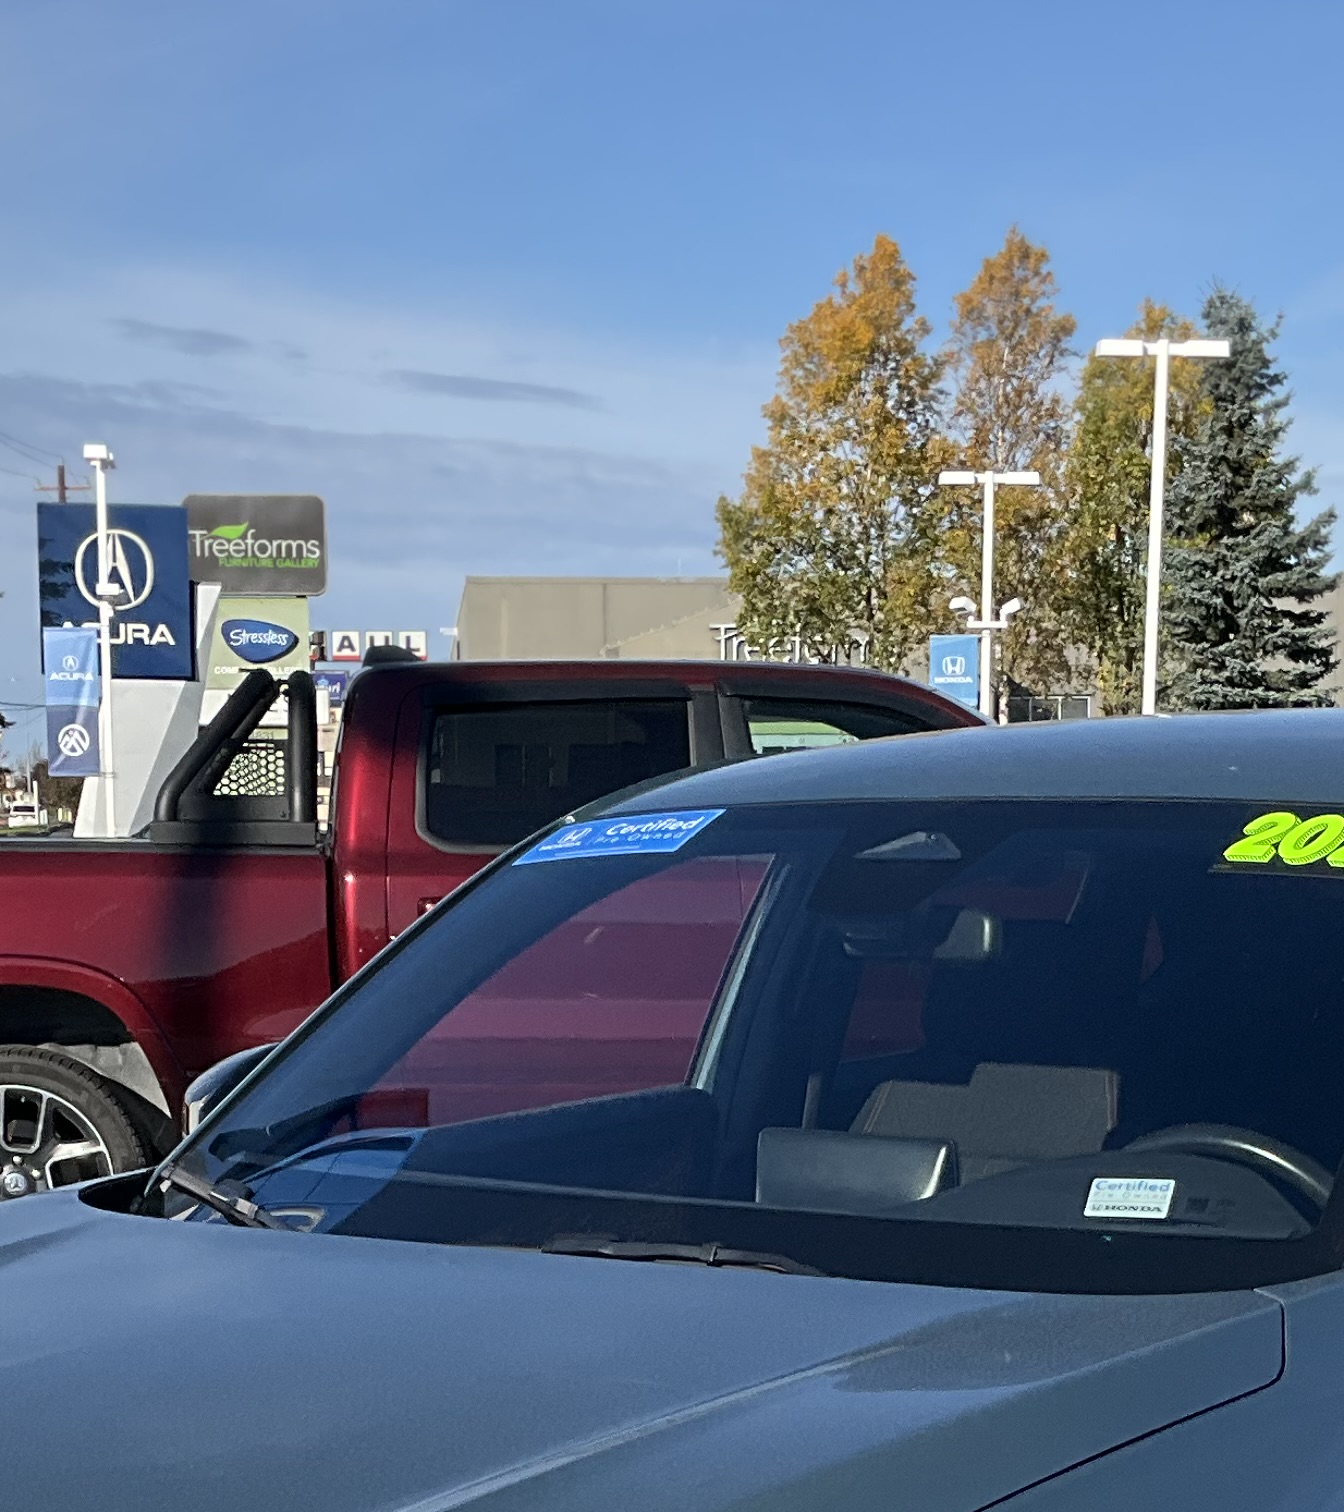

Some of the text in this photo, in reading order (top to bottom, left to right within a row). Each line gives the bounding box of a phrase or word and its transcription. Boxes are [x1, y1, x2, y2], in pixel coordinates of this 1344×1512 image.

[188, 529, 320, 558] Treeforms
[218, 559, 319, 568] FURNITURE GALLERY
[62, 621, 176, 646] URA
[229, 629, 289, 646] Stressless
[49, 672, 94, 681] ACURA
[606, 816, 705, 836] Certified
[1095, 1180, 1171, 1193] Certified
[1104, 1204, 1163, 1213] HONDA
